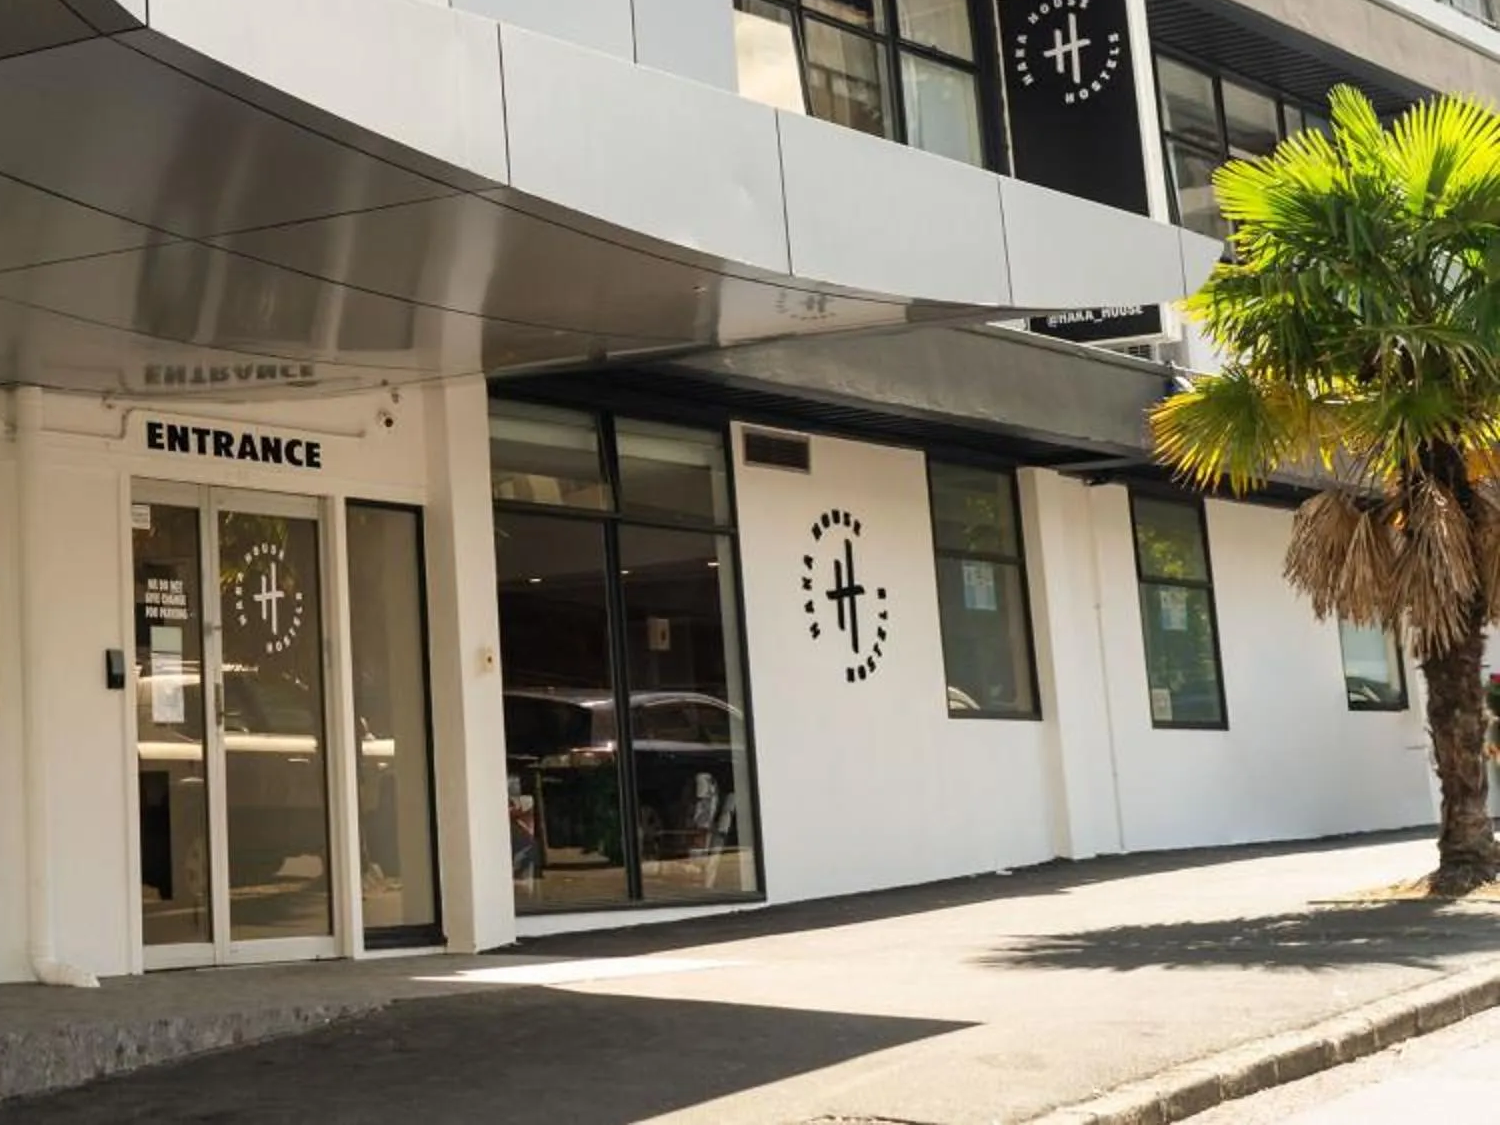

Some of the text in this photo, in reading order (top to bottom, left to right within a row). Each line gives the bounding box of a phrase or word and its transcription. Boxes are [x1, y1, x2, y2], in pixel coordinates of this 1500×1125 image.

[1015, 35, 1034, 86] HAKA
[1065, 33, 1120, 104] HOSTELS
[146, 422, 322, 468] ENTRANCE
